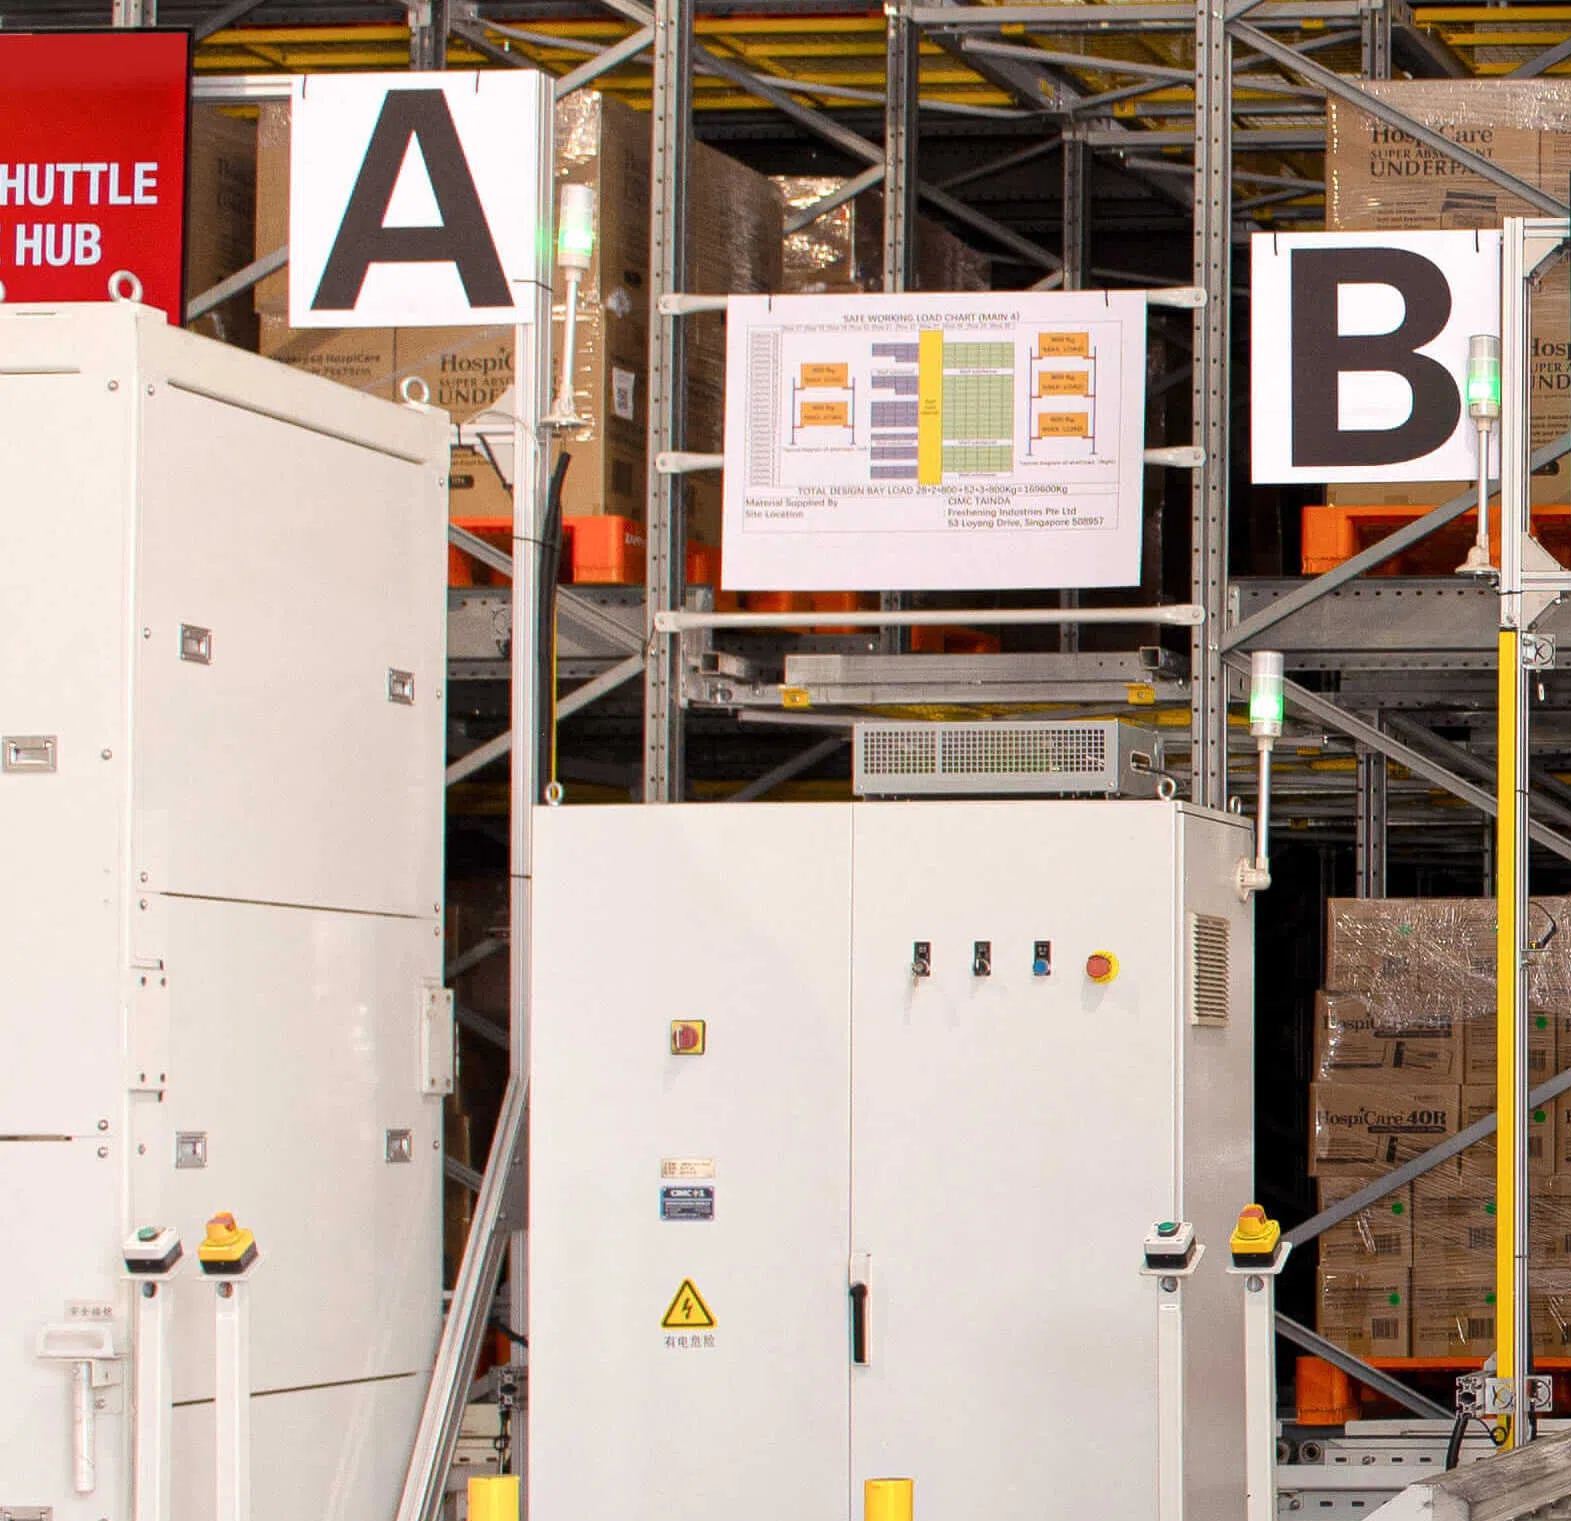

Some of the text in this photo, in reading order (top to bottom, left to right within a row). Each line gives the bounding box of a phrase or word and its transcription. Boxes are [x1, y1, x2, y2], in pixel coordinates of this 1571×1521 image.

[1370, 159, 1476, 177] UNDERPA
[310, 88, 514, 311] A
[15, 223, 102, 267] HUB
[843, 313, 866, 323] SAFE
[867, 312, 914, 323] WORKING
[916, 312, 943, 323] LOAD
[944, 312, 976, 322] CHART
[1290, 247, 1462, 467] B
[798, 486, 828, 496] TOTAL
[745, 497, 784, 507] Material
[786, 497, 825, 508] Supplied
[745, 509, 762, 519] Site
[1406, 1110, 1447, 1125] 40R
